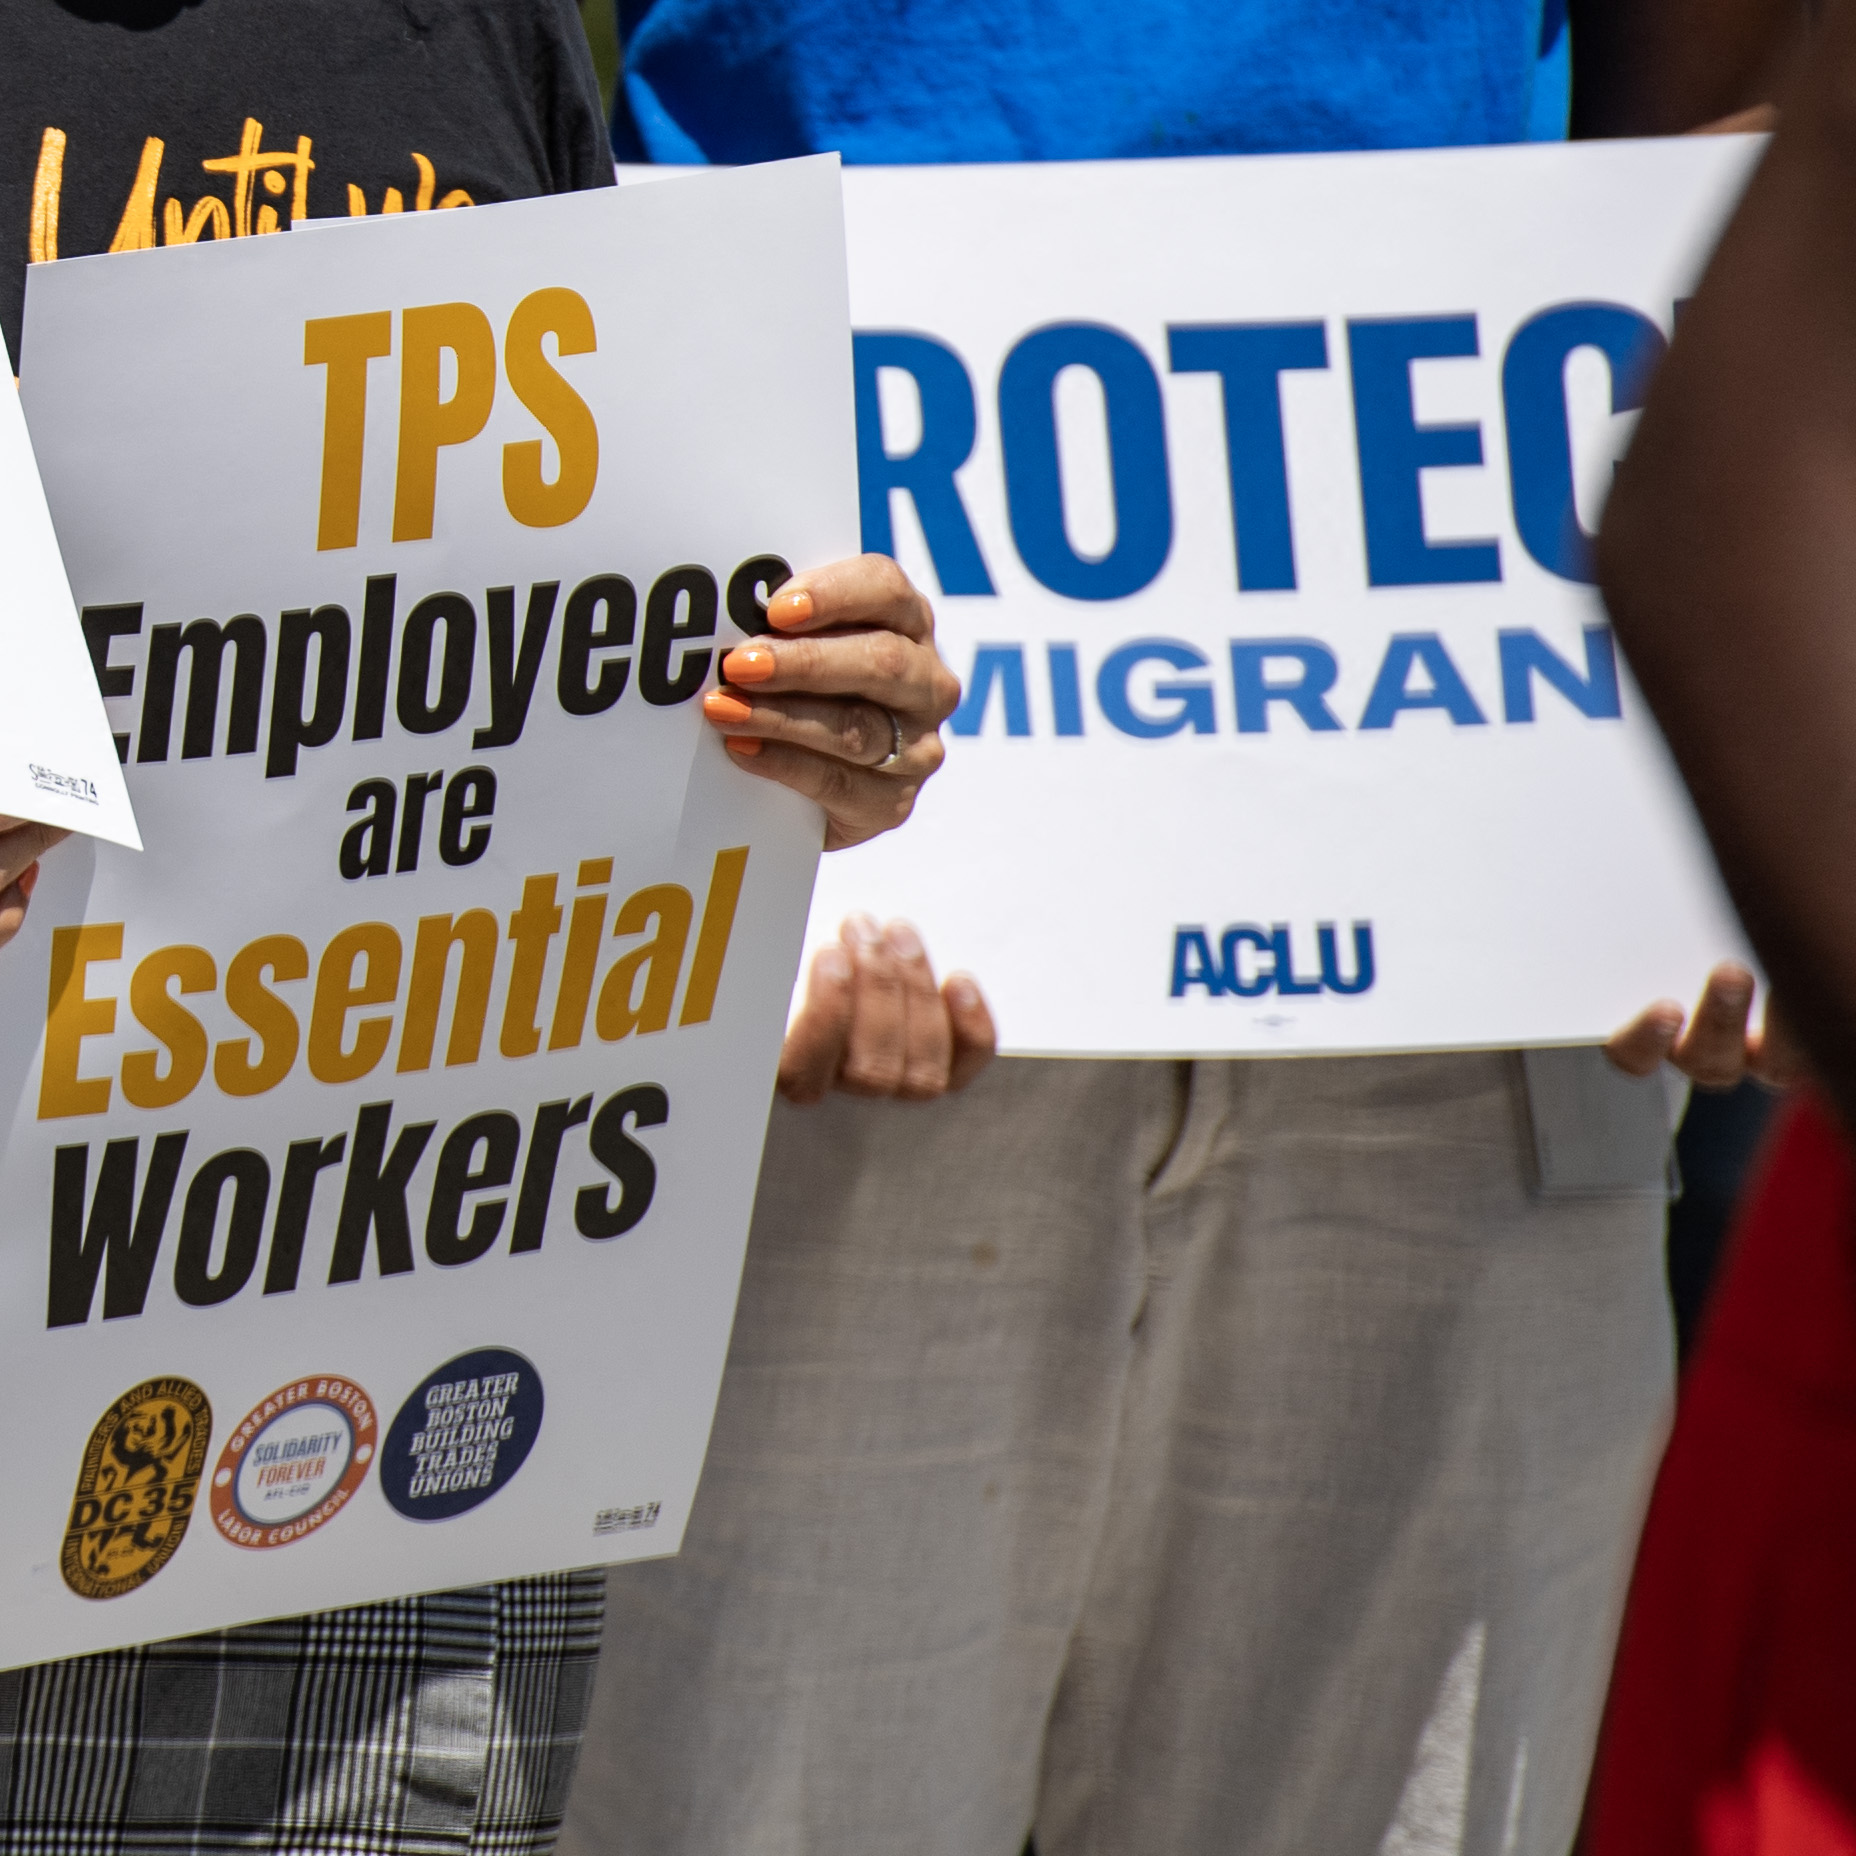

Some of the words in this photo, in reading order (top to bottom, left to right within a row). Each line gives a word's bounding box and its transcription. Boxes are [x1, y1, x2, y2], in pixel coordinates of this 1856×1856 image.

[303, 286, 600, 552] TPS
[852, 299, 1678, 602] ROTEC
[940, 625, 1622, 740] MIGRAN
[338, 764, 497, 881] are
[36, 845, 751, 1122] Essential
[1168, 920, 1376, 999] ACLU
[46, 1080, 671, 1331] Workers
[316, 1380, 374, 1431] BOSTON
[425, 1372, 520, 1409] GREATER
[425, 1395, 510, 1431] BOSTON
[253, 1430, 343, 1466] SOLIDARITY
[409, 1416, 515, 1456] BUILDING
[416, 1440, 499, 1476] TRADES
[256, 1456, 326, 1489] FOREVER
[409, 1463, 493, 1498] UNIONS
[70, 1493, 134, 1530] DC
[139, 1483, 195, 1518] 35
